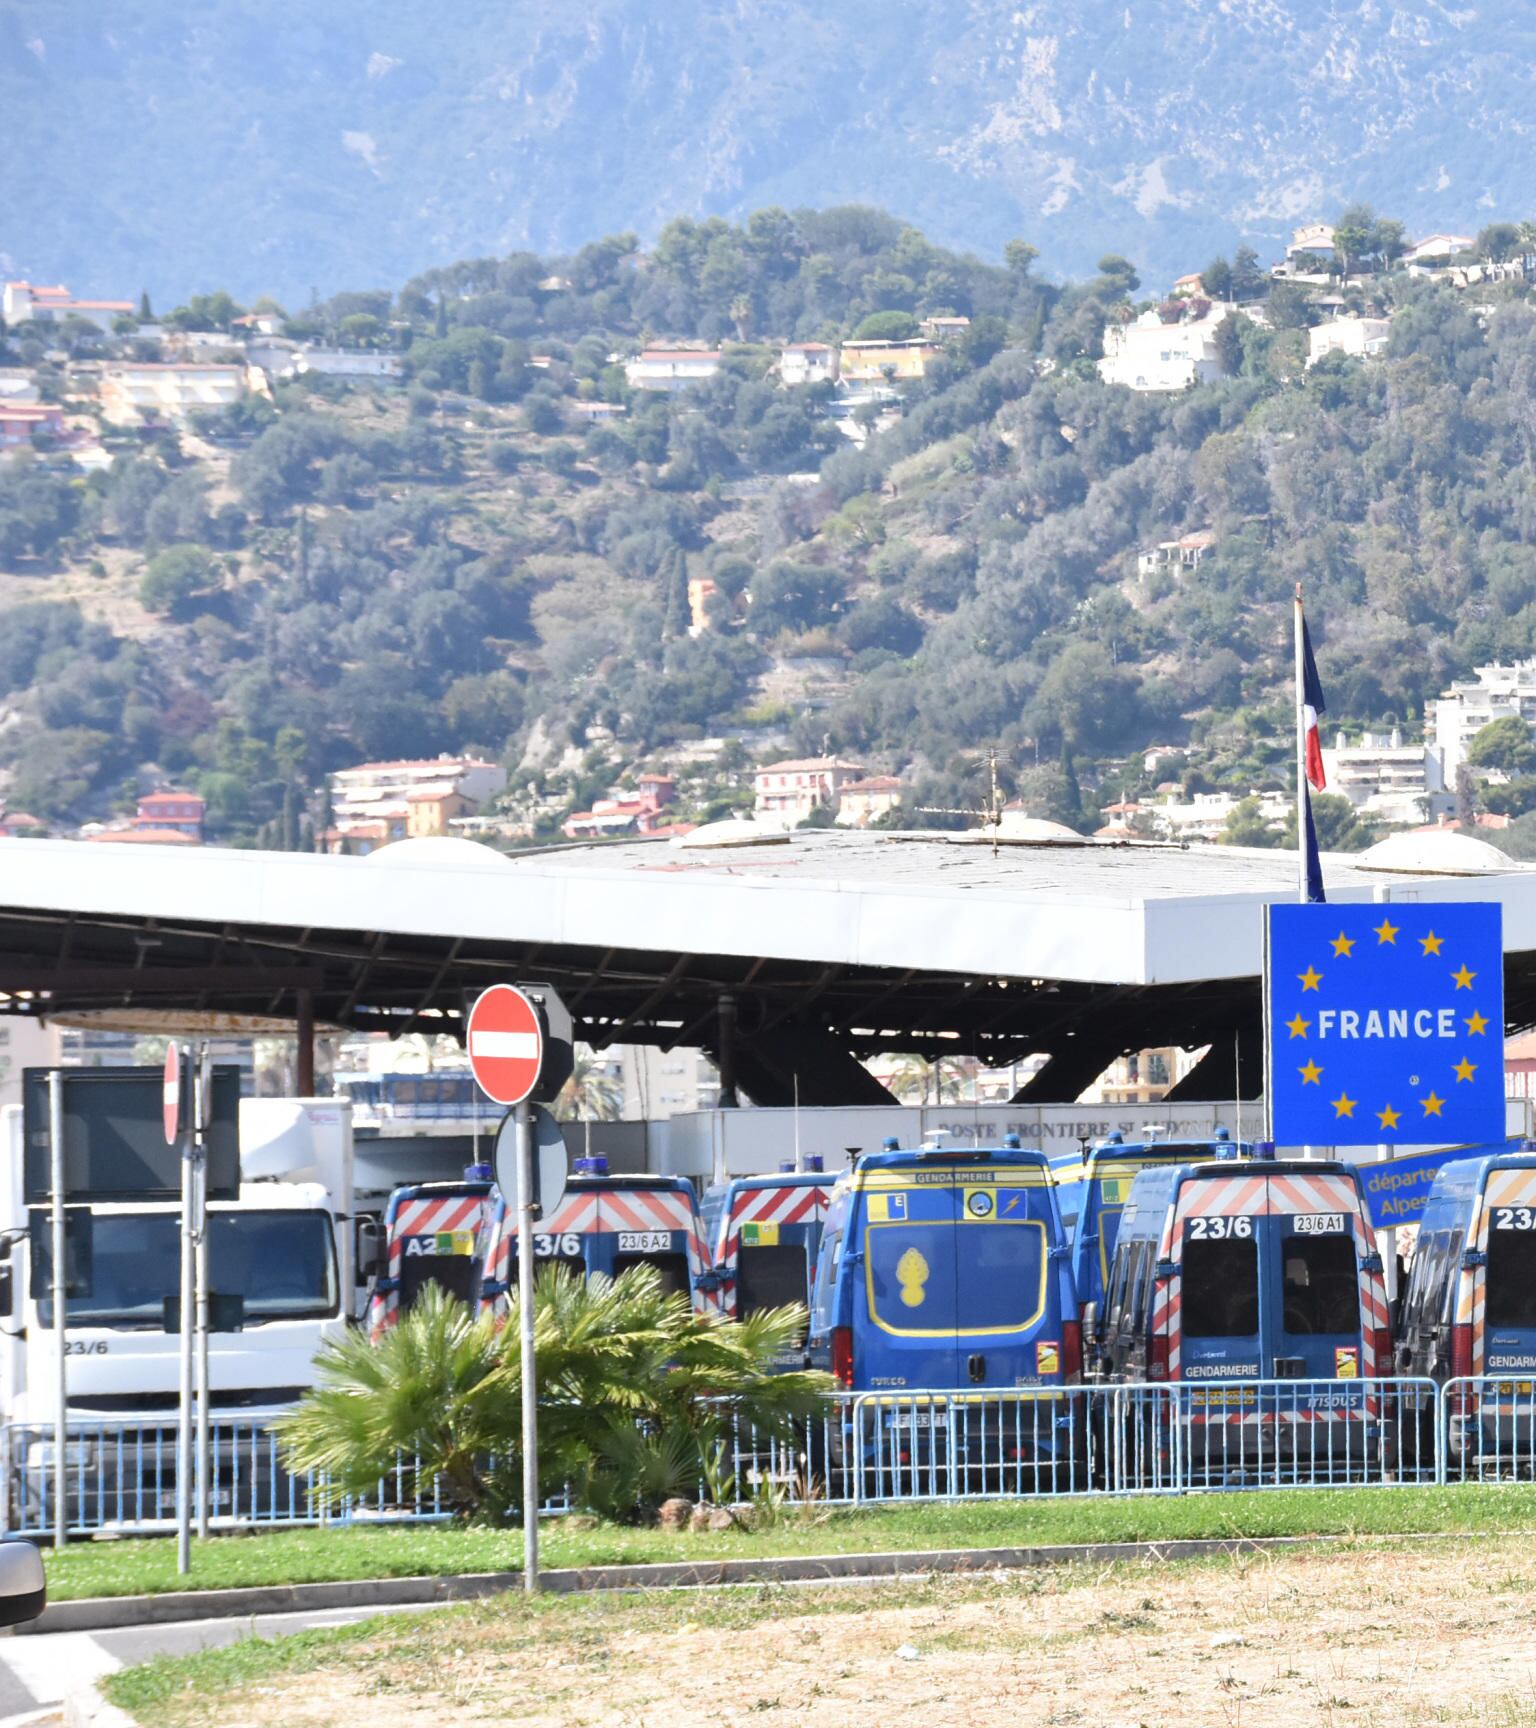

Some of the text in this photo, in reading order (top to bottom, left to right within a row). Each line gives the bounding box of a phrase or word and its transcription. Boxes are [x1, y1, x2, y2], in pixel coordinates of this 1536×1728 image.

[1319, 1009, 1457, 1038] FRANCE
[917, 1172, 993, 1183] GENDARMERIE
[1368, 1166, 1441, 1193] départe
[895, 1196, 904, 1206] E
[1190, 1216, 1252, 1240] 23/6
[1299, 1216, 1344, 1231] 23/6 A1
[405, 1237, 436, 1256] A2
[515, 1234, 580, 1256] 3/6
[621, 1235, 649, 1249] 23/6
[64, 1341, 108, 1355] 23/6
[1185, 1364, 1259, 1377] GENDARMERIE
